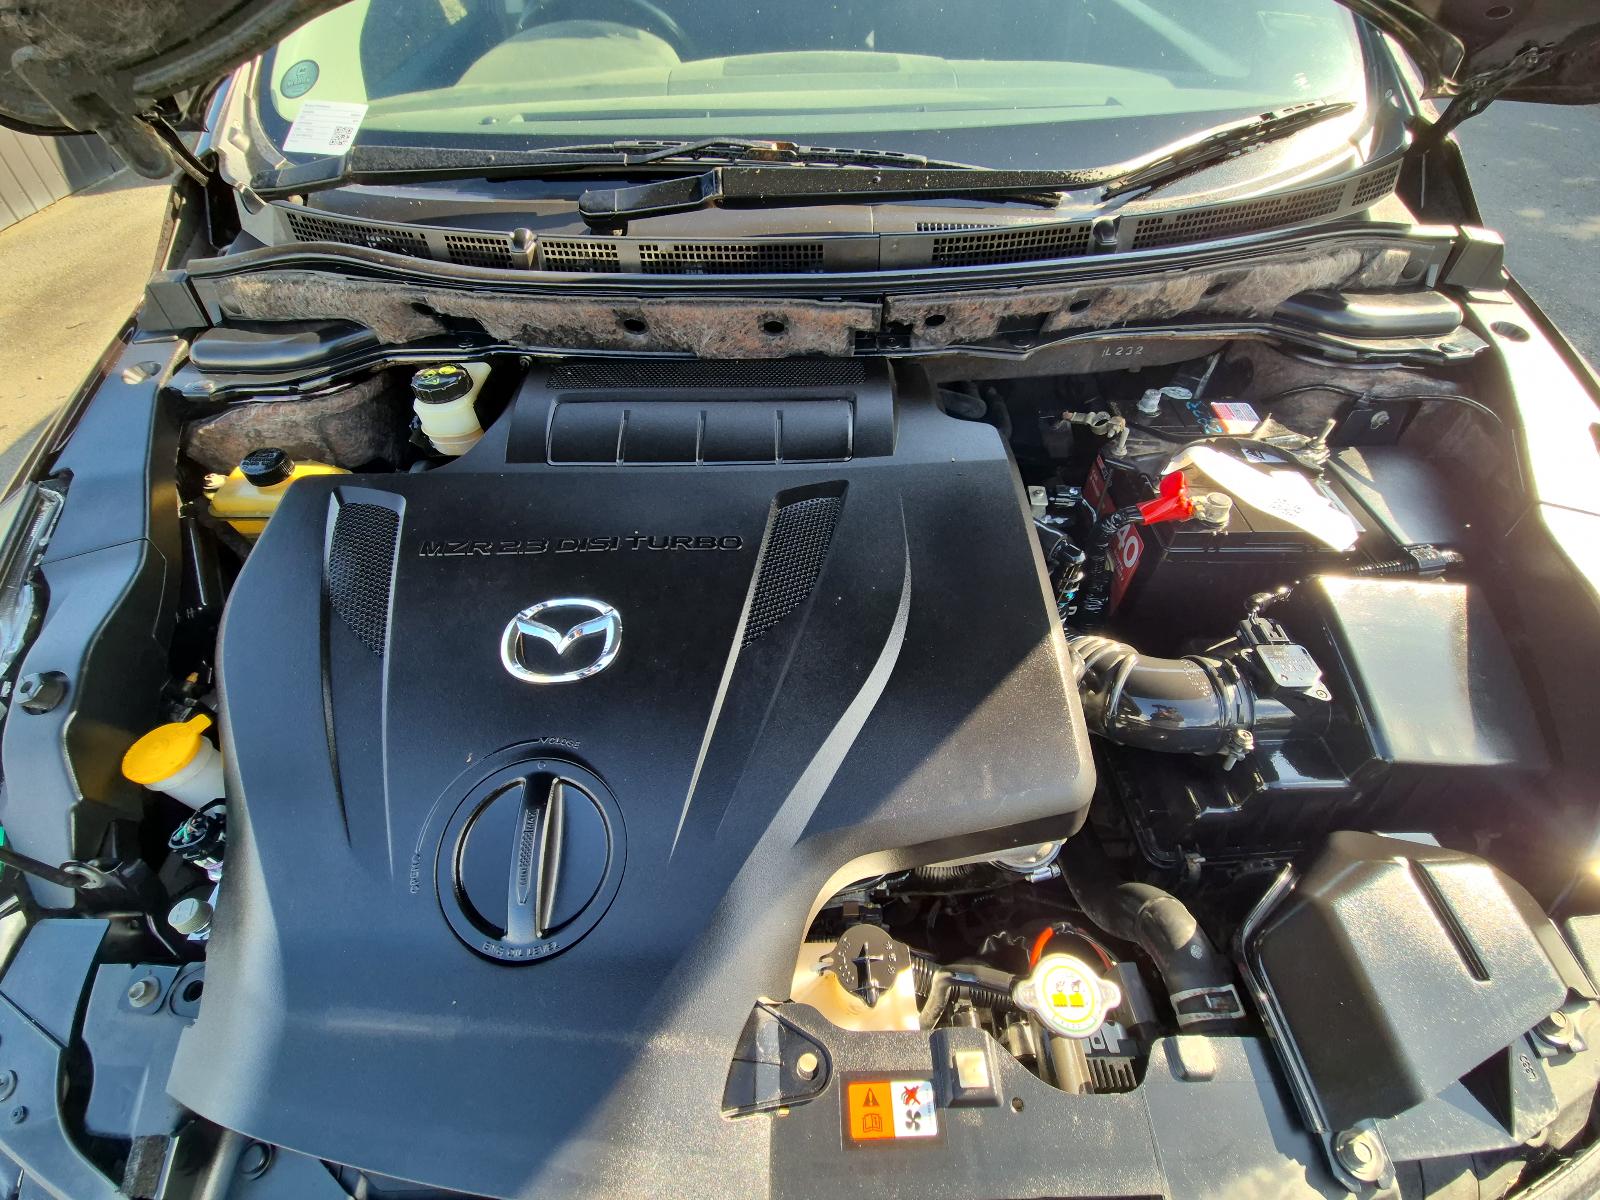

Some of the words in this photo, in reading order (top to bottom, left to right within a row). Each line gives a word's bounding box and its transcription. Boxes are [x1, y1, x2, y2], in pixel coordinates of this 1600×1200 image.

[418, 540, 494, 557] MZR
[496, 539, 550, 555] 2.3
[554, 536, 621, 553] DISI
[624, 535, 744, 551] TURBO
[548, 736, 581, 750] CLOSE
